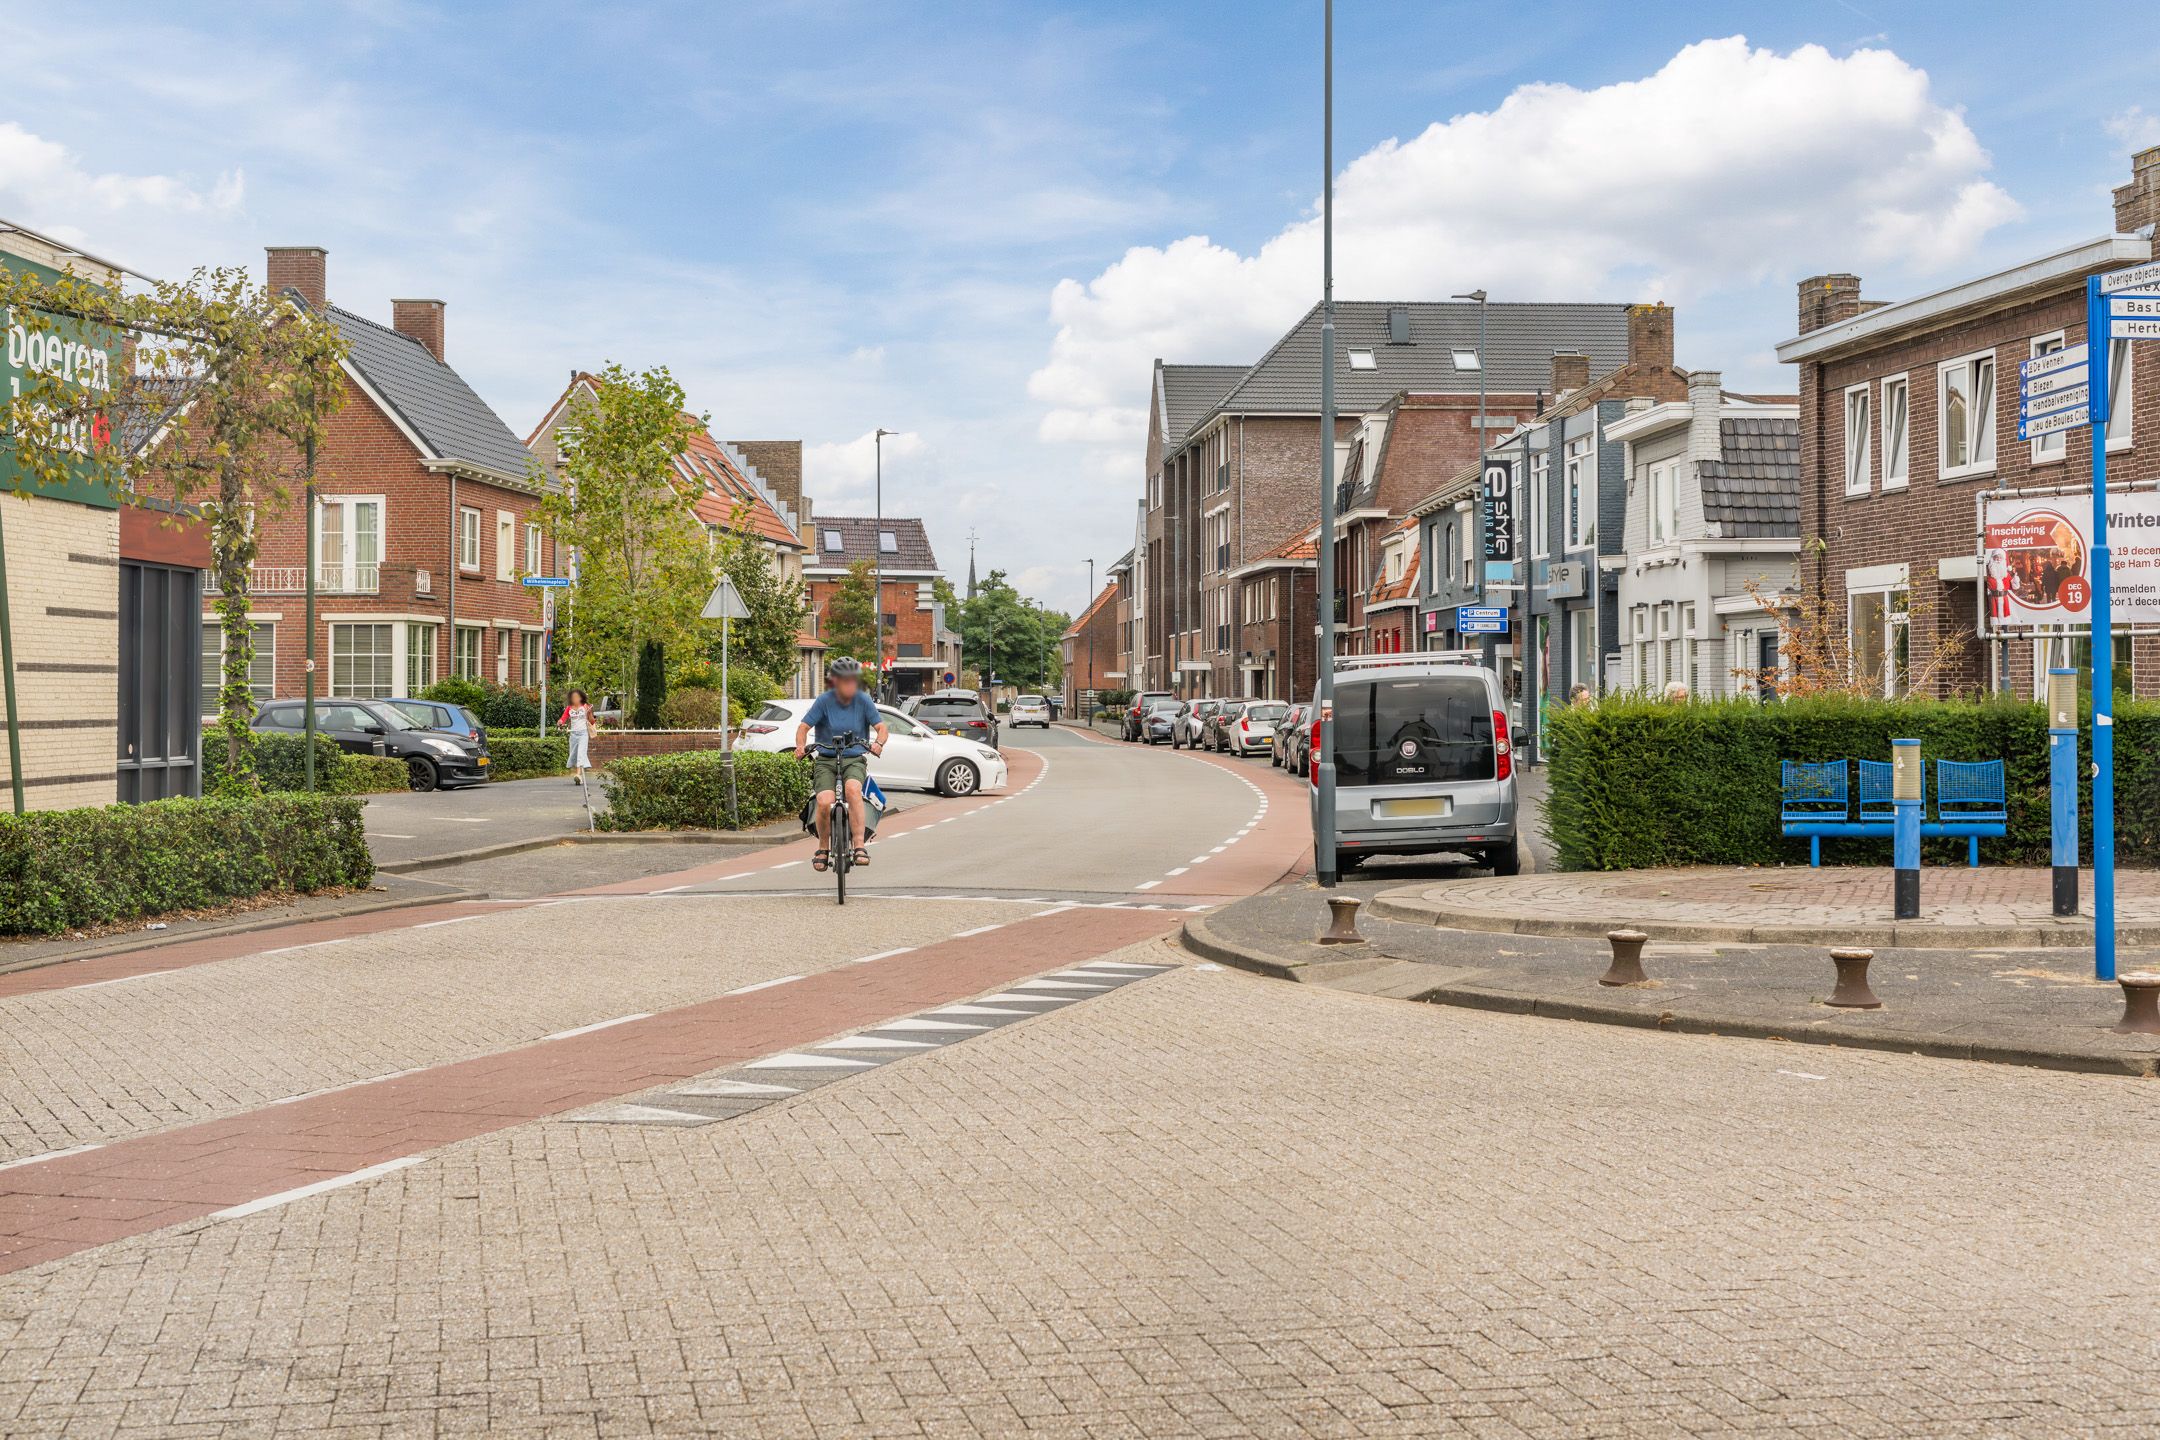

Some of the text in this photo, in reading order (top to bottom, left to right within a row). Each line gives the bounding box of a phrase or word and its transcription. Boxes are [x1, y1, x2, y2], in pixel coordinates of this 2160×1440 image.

[2108, 265, 2160, 287] Overige objecte
[2127, 302, 2152, 312] Bas
[2128, 322, 2160, 333] Hert
[8, 304, 110, 393] boeren
[2033, 355, 2064, 373] De Vennen
[2033, 380, 2054, 393] Biezen
[2033, 388, 2088, 411] Handbalvereniging
[2032, 407, 2089, 432] Jeu de Boules Club
[1485, 501, 1494, 527] HAAR
[1991, 525, 2045, 536] Inschrijving
[2001, 536, 2034, 548] gestart
[2117, 547, 2128, 556] 19
[2109, 560, 2126, 570] oge
[2128, 559, 2151, 568] Ham
[2110, 584, 2155, 593] anmelden
[2067, 592, 2082, 604] 19
[2127, 597, 2133, 606] 1
[2135, 596, 2160, 606] dece
